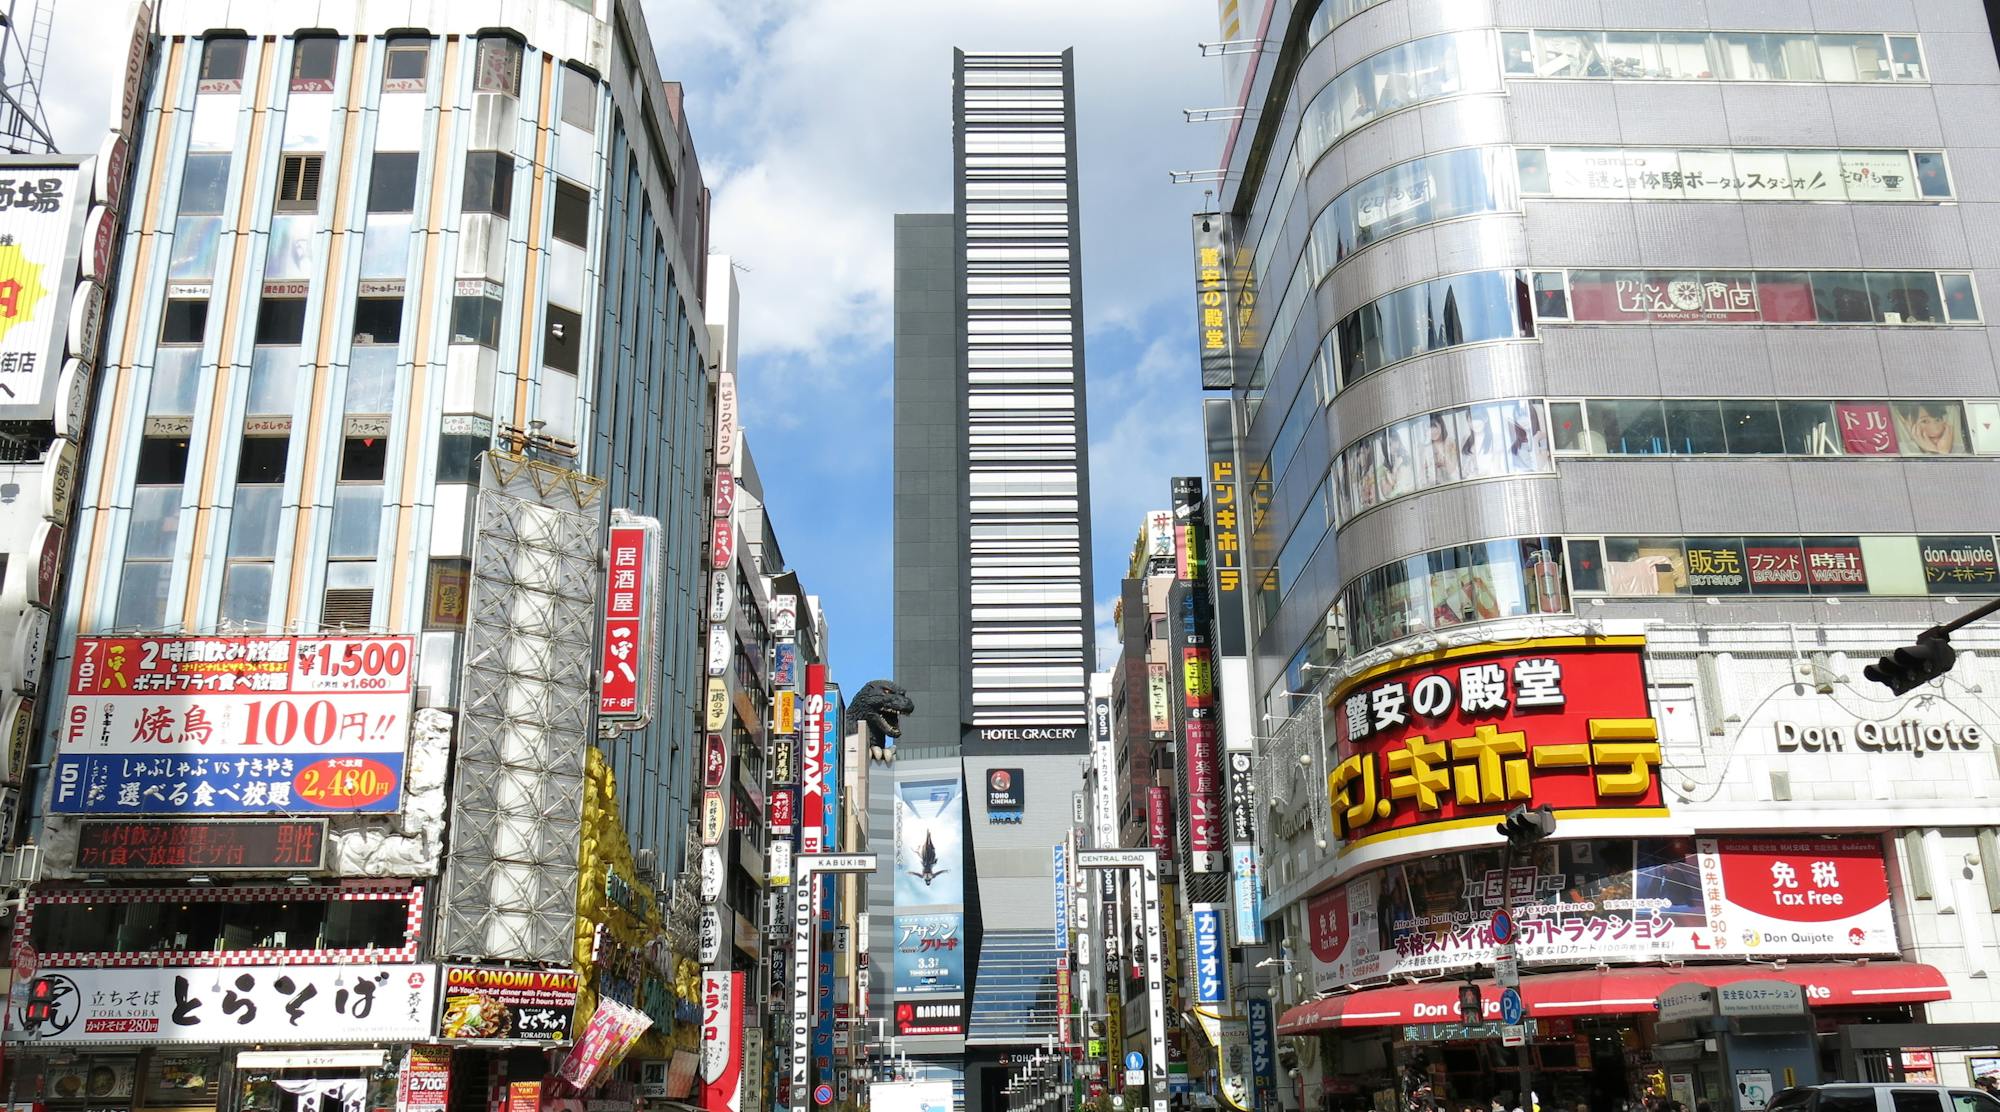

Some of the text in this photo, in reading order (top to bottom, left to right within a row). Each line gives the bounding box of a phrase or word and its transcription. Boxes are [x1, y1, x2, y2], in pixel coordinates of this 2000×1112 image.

[1200, 247, 1225, 350] 驚安の殿堂
[1212, 461, 1240, 592] ドン・キホーテ
[716, 530, 731, 556] つぼ八
[1688, 550, 1741, 574] 販売
[1749, 553, 1800, 570] ブランド
[1810, 552, 1860, 570] 時計
[612, 547, 637, 612] 居酒屋
[1753, 569, 1801, 583] BRAND
[1811, 568, 1863, 583] WATCH
[1925, 566, 1997, 583] ドン・キホーテ
[102, 645, 127, 689] つぼ八
[139, 640, 291, 670] 2時間飲み放題
[299, 642, 407, 677] ¥1,500
[603, 626, 636, 684] つぼ八
[132, 672, 289, 692] ポテトフライ食べ放題
[1344, 657, 1567, 742] 驚安の殿堂
[68, 705, 88, 743] 6F
[131, 704, 213, 745] 焼鳥
[1192, 708, 1208, 718] 6F
[804, 694, 824, 796] SHIDAX
[981, 728, 1078, 740] HOTEL GRACERY
[1774, 718, 1983, 757] Don Quijote
[122, 758, 209, 778] しゃぶしゃぶ
[234, 758, 295, 778] すきやき
[1194, 742, 1213, 793] 居楽屋
[58, 763, 80, 803] 5F
[117, 780, 292, 808] 選べる食べ放題
[302, 768, 390, 799] 2,480円
[1121, 854, 1145, 862] ROAD
[1527, 900, 1596, 915] experience
[1703, 842, 1727, 950] この先徒歩90秒
[1772, 889, 1844, 906] Tax Free
[1394, 915, 1675, 957] 本格スパイ体アトラクション
[1764, 931, 1835, 945] Don Quijote
[1198, 913, 1221, 999] カラオケ
[449, 967, 579, 989] OKONOMI YAKI
[794, 890, 809, 1065] GODZILLA ROAD
[91, 991, 161, 1007] 立ちそば
[171, 971, 390, 1026] とらそば
[448, 986, 499, 995] All-You-Can-Eat
[500, 988, 521, 996] dinner
[536, 990, 576, 999] Free-Flowing
[498, 996, 519, 1004] Drinks
[535, 997, 554, 1006] hours
[1722, 989, 1798, 1000] 安全安心ステーション
[92, 1009, 156, 1018] TORA SOBA
[916, 1004, 961, 1018] MARUHAN
[1413, 1002, 1448, 1018] Don
[1503, 997, 1512, 1020] P
[87, 1019, 158, 1033] かけそば 280円
[1251, 1002, 1270, 1073] カラオケ
